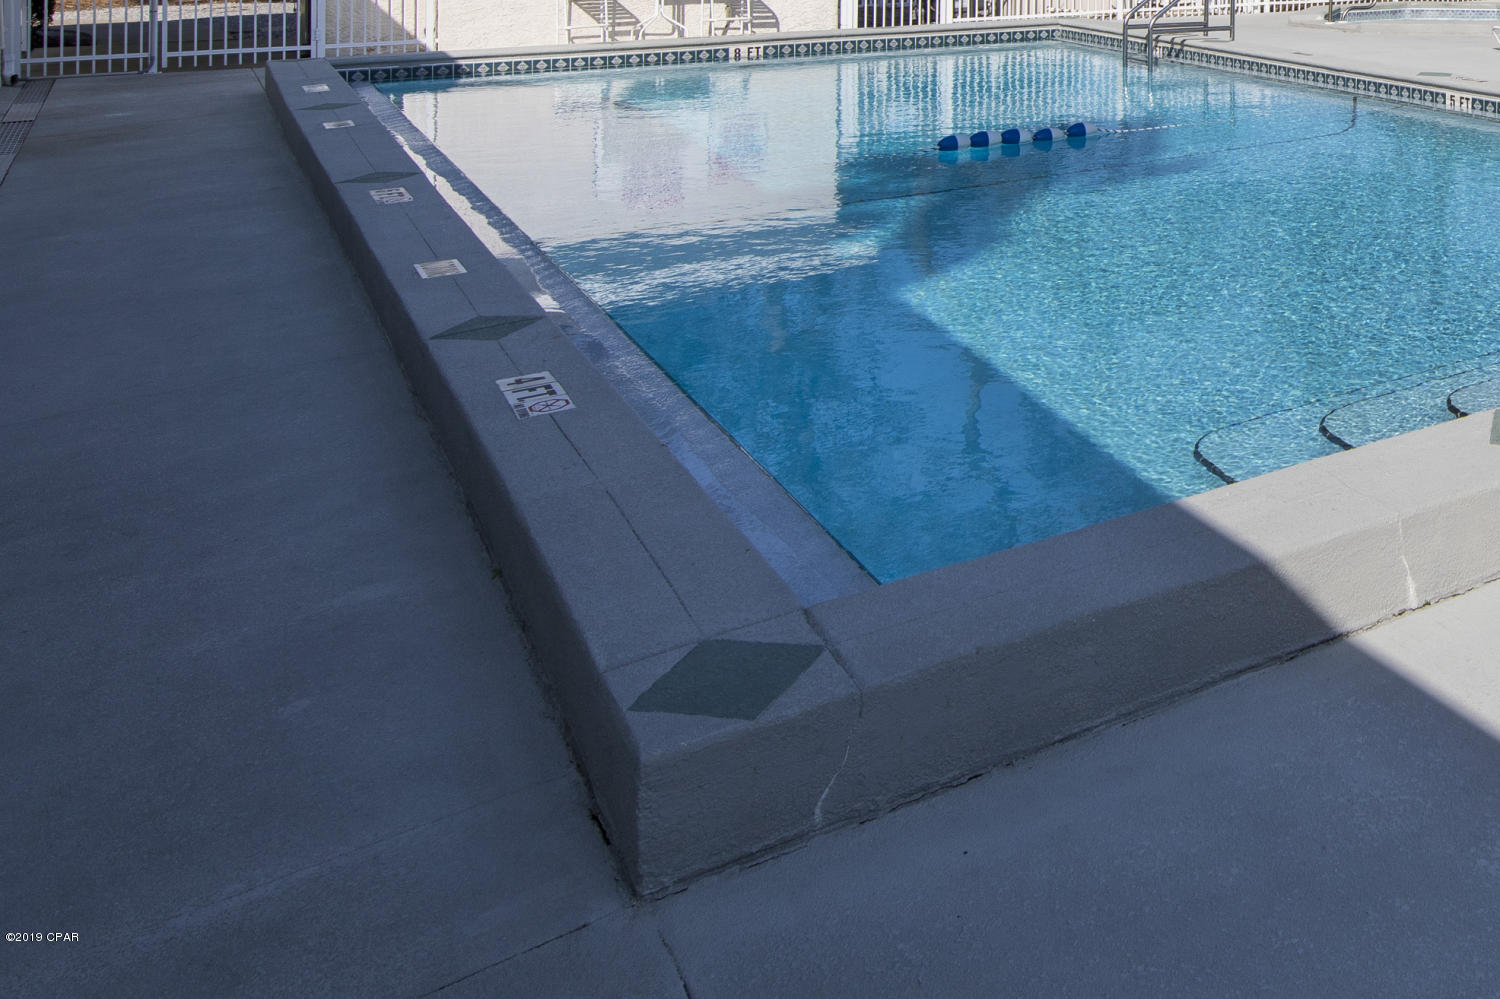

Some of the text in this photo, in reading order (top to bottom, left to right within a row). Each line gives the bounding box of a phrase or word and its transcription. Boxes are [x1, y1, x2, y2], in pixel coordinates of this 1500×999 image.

[734, 47, 761, 58] 8 FT
[1450, 95, 1470, 108] 5 FT
[506, 376, 546, 386] 4
